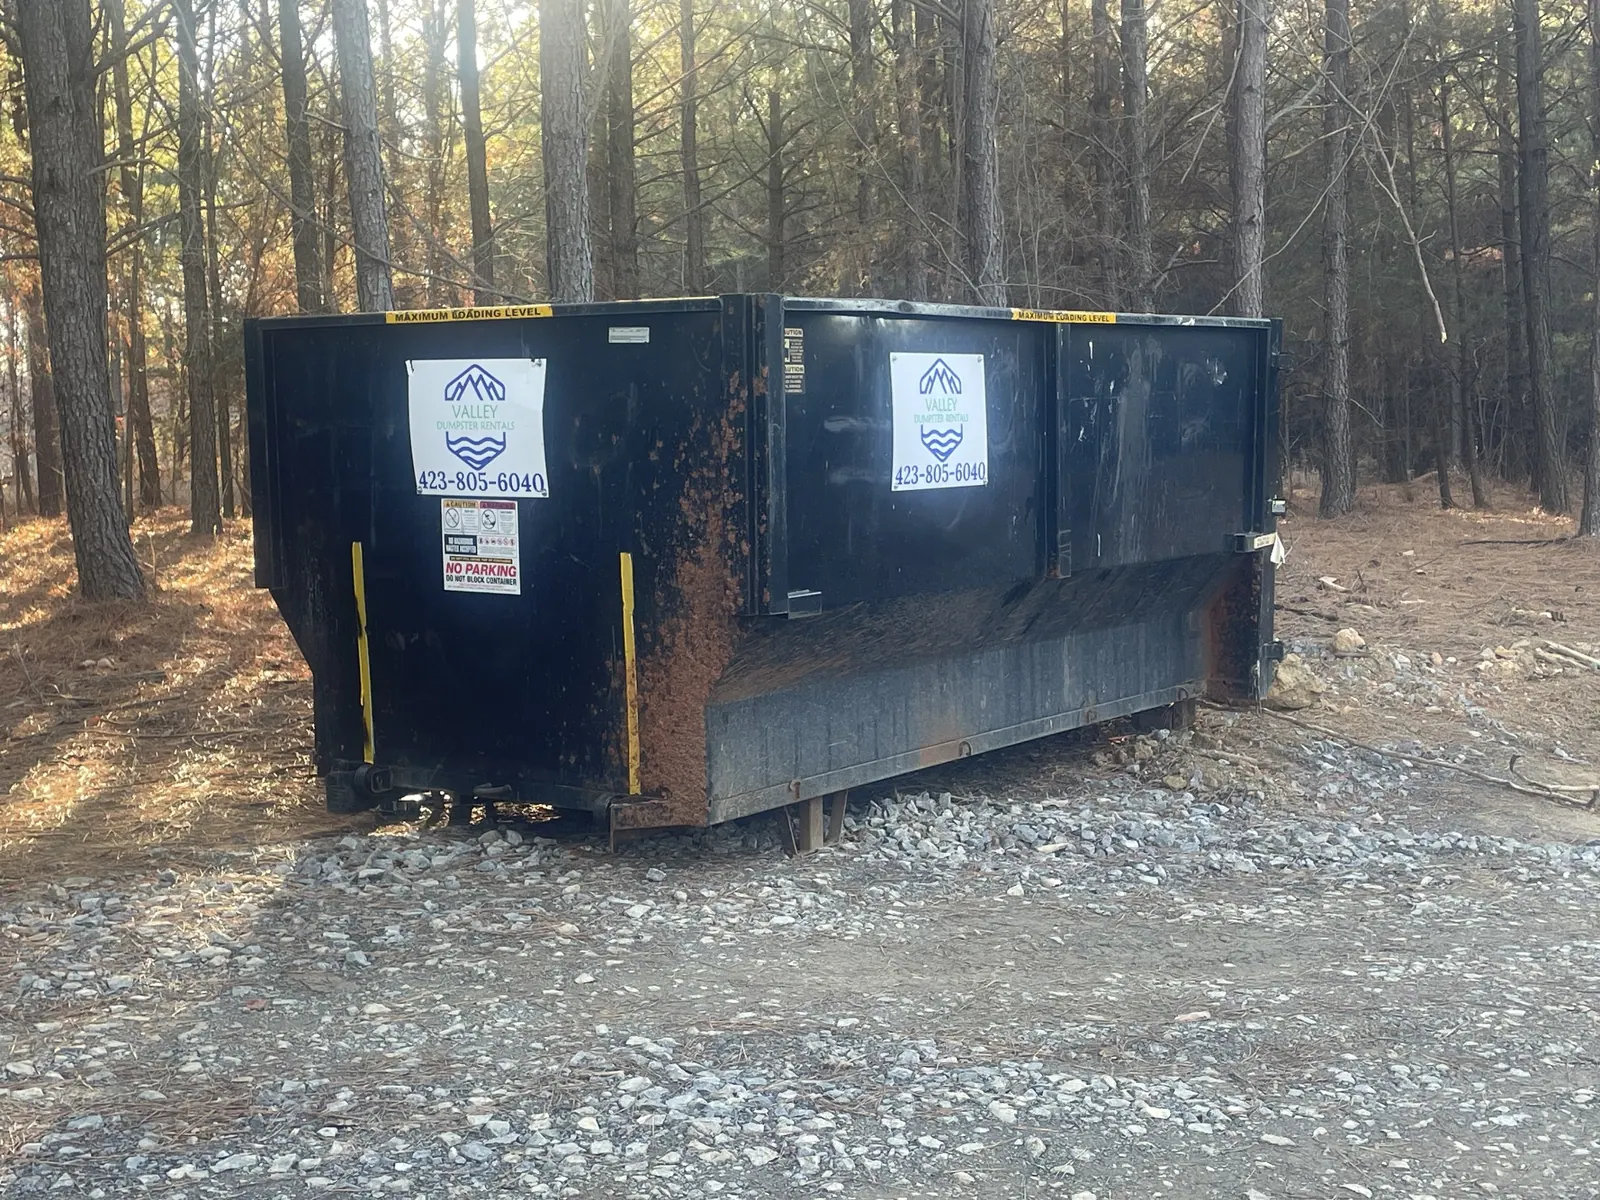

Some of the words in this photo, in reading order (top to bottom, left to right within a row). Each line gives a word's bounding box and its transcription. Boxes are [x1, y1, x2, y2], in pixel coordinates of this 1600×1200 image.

[395, 310, 448, 322] MAXIMUM
[452, 308, 501, 320] LOADING
[505, 306, 541, 317] LEVEL
[1018, 311, 1054, 320] MAXIMUM
[1056, 312, 1087, 321] LOADING
[1089, 314, 1110, 322] LEVEL
[452, 404, 498, 419] VALLEY
[925, 398, 957, 412] VALLEY
[914, 413, 945, 424] DUMPSTER
[946, 413, 969, 423] RENTALS
[436, 421, 478, 430] DUMPSTER
[481, 421, 515, 431] RENTALS
[895, 461, 986, 485] 423-805-6040
[419, 471, 544, 492] 423-805-6040
[446, 562, 462, 574] NO
[466, 564, 517, 577] PARKING
[446, 574, 453, 582] DO
[486, 577, 516, 585] CONTAINER
